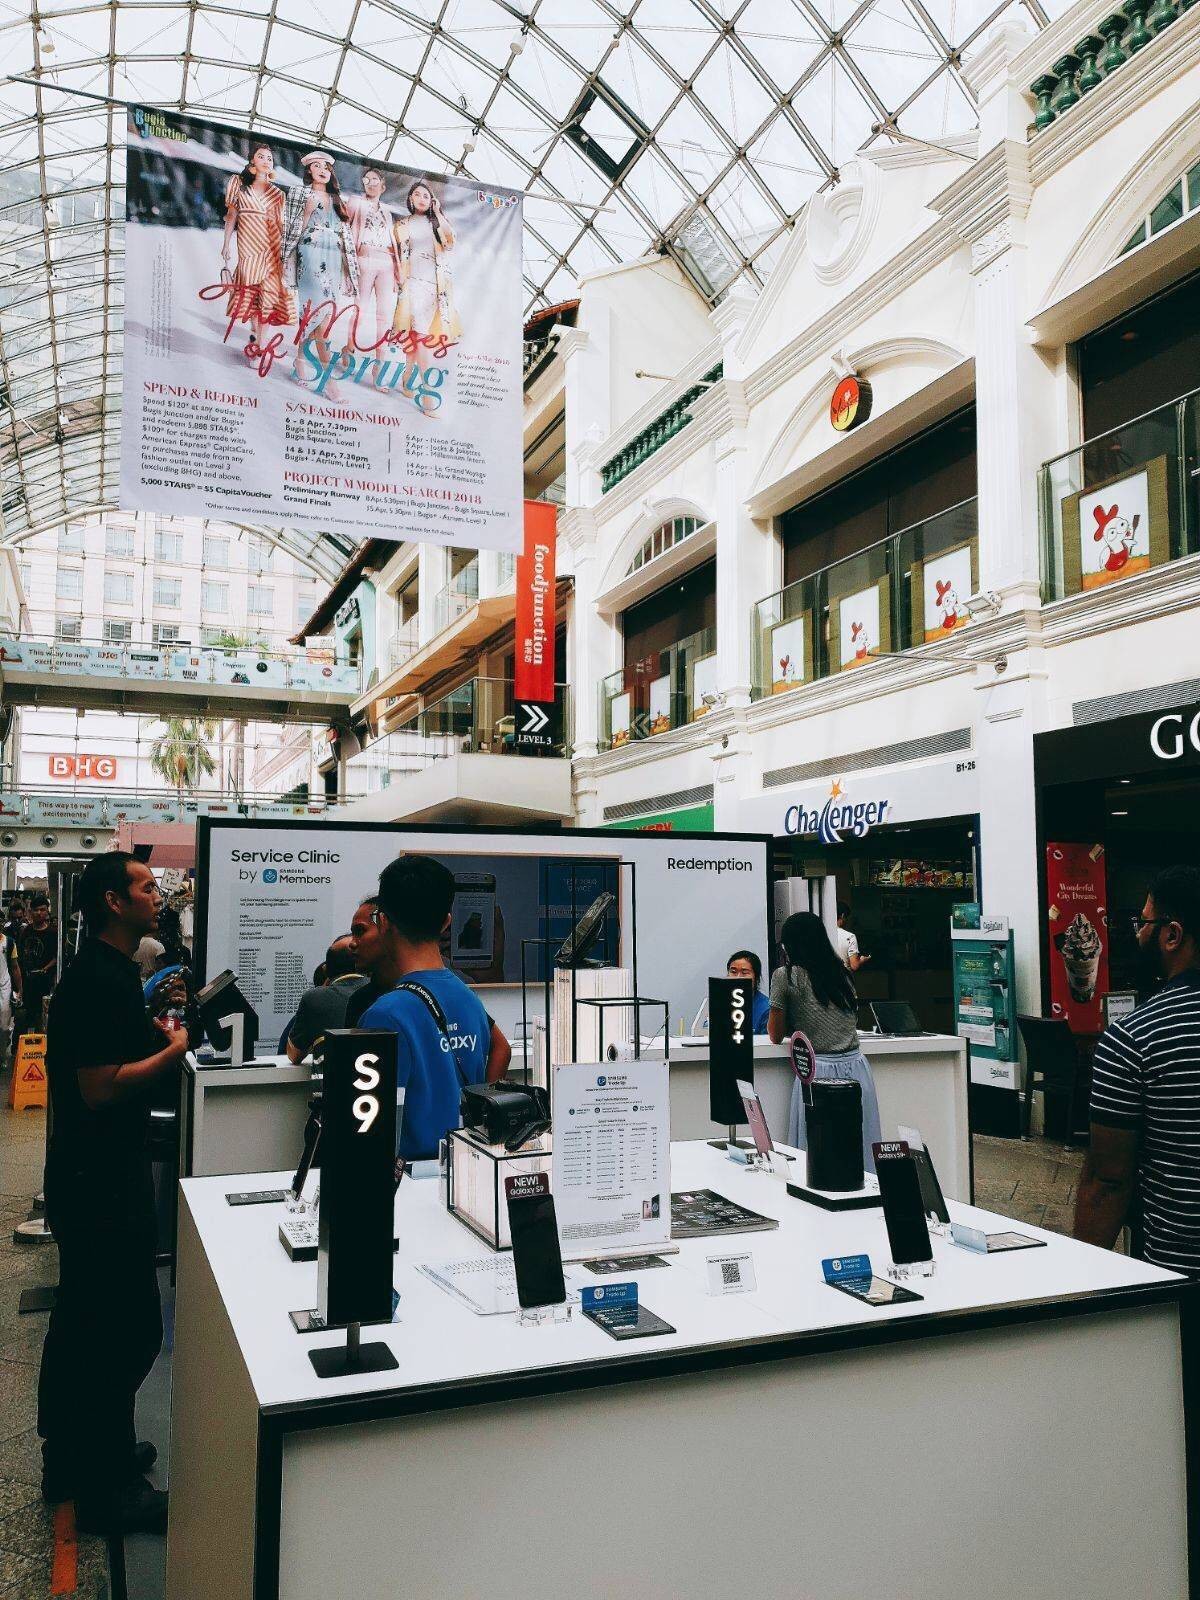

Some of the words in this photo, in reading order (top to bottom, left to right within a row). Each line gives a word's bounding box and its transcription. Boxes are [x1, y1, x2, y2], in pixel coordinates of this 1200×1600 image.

[135, 109, 165, 126] Bugis
[140, 123, 187, 143] Junction
[293, 299, 460, 358] Muses
[244, 333, 288, 377] of
[292, 335, 450, 413] Spring
[143, 396, 165, 406] Spend
[144, 382, 187, 397] SPEND
[190, 388, 200, 398] &
[205, 390, 258, 408] REDEEM
[143, 406, 161, 415] Bugis
[163, 410, 193, 419] Junction
[309, 405, 363, 421] FASHION
[365, 413, 403, 427] SHOW
[158, 419, 185, 427] redeem
[286, 425, 304, 433] Bugis
[306, 427, 337, 436] Junction
[142, 434, 176, 445] American
[180, 432, 207, 440] charges
[209, 434, 228, 442] made
[285, 432, 304, 441] Bugis
[336, 438, 355, 447] Level
[153, 446, 189, 456] purchases
[191, 451, 210, 459] made
[212, 453, 230, 461] from
[285, 453, 308, 462] Bugis+
[346, 461, 364, 469] Level
[340, 453, 369, 462] 7.30pm
[141, 453, 167, 462] fashion
[170, 458, 191, 466] outlet
[206, 460, 224, 470] Level
[141, 463, 179, 475] (excluding
[141, 478, 162, 486] 5,000
[216, 487, 272, 498] CapitaVoucher
[284, 471, 340, 488] PROJECT
[356, 480, 401, 495] MODEL
[403, 485, 451, 501] SEARCH
[454, 492, 482, 504] 2018
[284, 484, 328, 498] Preliminary
[330, 490, 361, 501] Runway
[284, 495, 308, 505] Grand
[310, 497, 332, 507] Finals
[531, 543, 550, 665] foodjunction
[518, 734, 545, 744] LEVEL
[546, 736, 552, 745] 3
[53, 756, 114, 777] BHG
[956, 760, 976, 773] B1-26
[784, 799, 888, 843] Challenger
[231, 849, 293, 863] Service
[298, 850, 341, 864] Clinic
[667, 857, 753, 875] Redemption
[239, 869, 257, 883] by
[279, 875, 331, 884] Members
[1059, 883, 1095, 892] Wonderful
[352, 1052, 380, 1134] S9
[880, 1143, 901, 1153] NEW!
[514, 1175, 539, 1187] NEW!
[510, 1187, 535, 1196] Galaxy
[535, 1185, 544, 1193] S9
